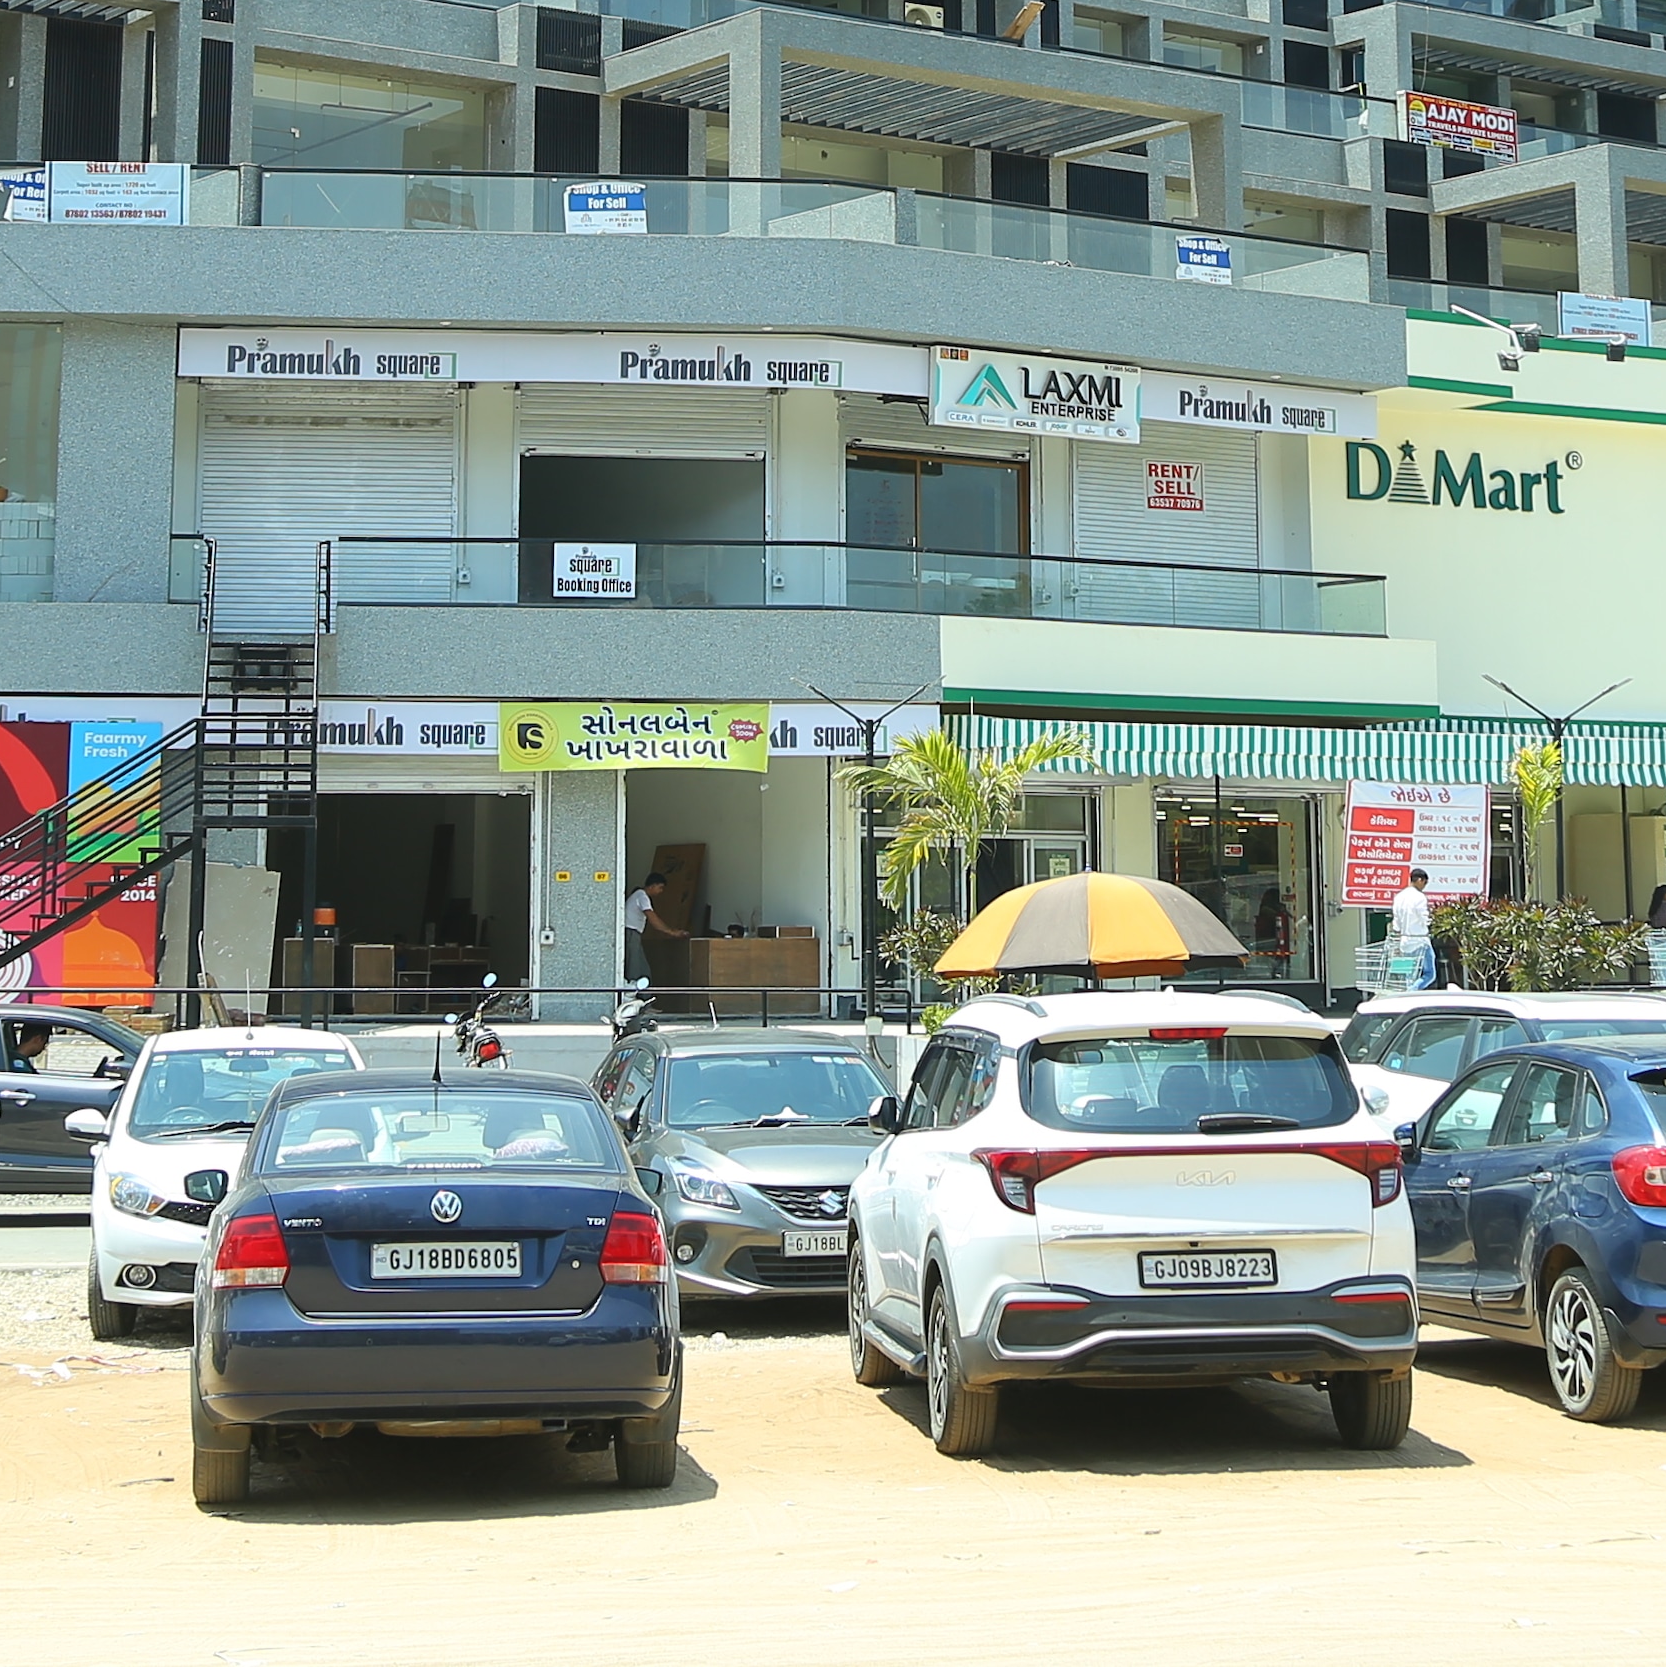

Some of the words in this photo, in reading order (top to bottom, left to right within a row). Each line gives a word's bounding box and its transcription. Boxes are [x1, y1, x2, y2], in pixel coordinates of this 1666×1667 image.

[1428, 104, 1468, 123] AJAY
[1473, 112, 1513, 133] MODI
[1428, 120, 1456, 132] TRAVELS
[1458, 124, 1486, 137] PRIVATE
[1488, 130, 1513, 142] LIMITED
[87, 163, 109, 173] SELL
[120, 163, 146, 173] RENT
[588, 198, 604, 209] For
[606, 197, 626, 209] Sell
[1189, 252, 1201, 262] For
[1202, 253, 1217, 264] Sell
[227, 339, 360, 376] Pramukh
[376, 351, 441, 379] square
[620, 345, 751, 381] Pramukh
[767, 358, 830, 385] square
[1018, 366, 1123, 408] LAXMI
[1032, 402, 1116, 422] ENTERPRISE
[1179, 389, 1271, 425] Pramukh
[1282, 406, 1325, 429] square
[950, 414, 974, 422] CERA
[1154, 480, 1196, 496] SELL
[569, 559, 612, 574] square
[557, 578, 599, 593] Booking
[602, 578, 631, 592] Office
[582, 707, 712, 734] સોનલબેન
[84, 731, 147, 746] Faarmy
[420, 723, 485, 749] square
[814, 726, 873, 751] squar
[84, 745, 128, 758] Fresh
[567, 740, 727, 760] ખાખરાવાળા
[1391, 786, 1432, 803] જોઈએ
[1437, 787, 1451, 803] છે
[120, 889, 156, 901] 2014
[1176, 1170, 1236, 1186] KIA
[283, 1218, 323, 1227] VENTO
[587, 1217, 606, 1226] TDI
[796, 1236, 844, 1252] GJ18BL
[390, 1248, 517, 1270] GJ18BD6805
[1154, 1258, 1271, 1279] GJ09BJ8223
